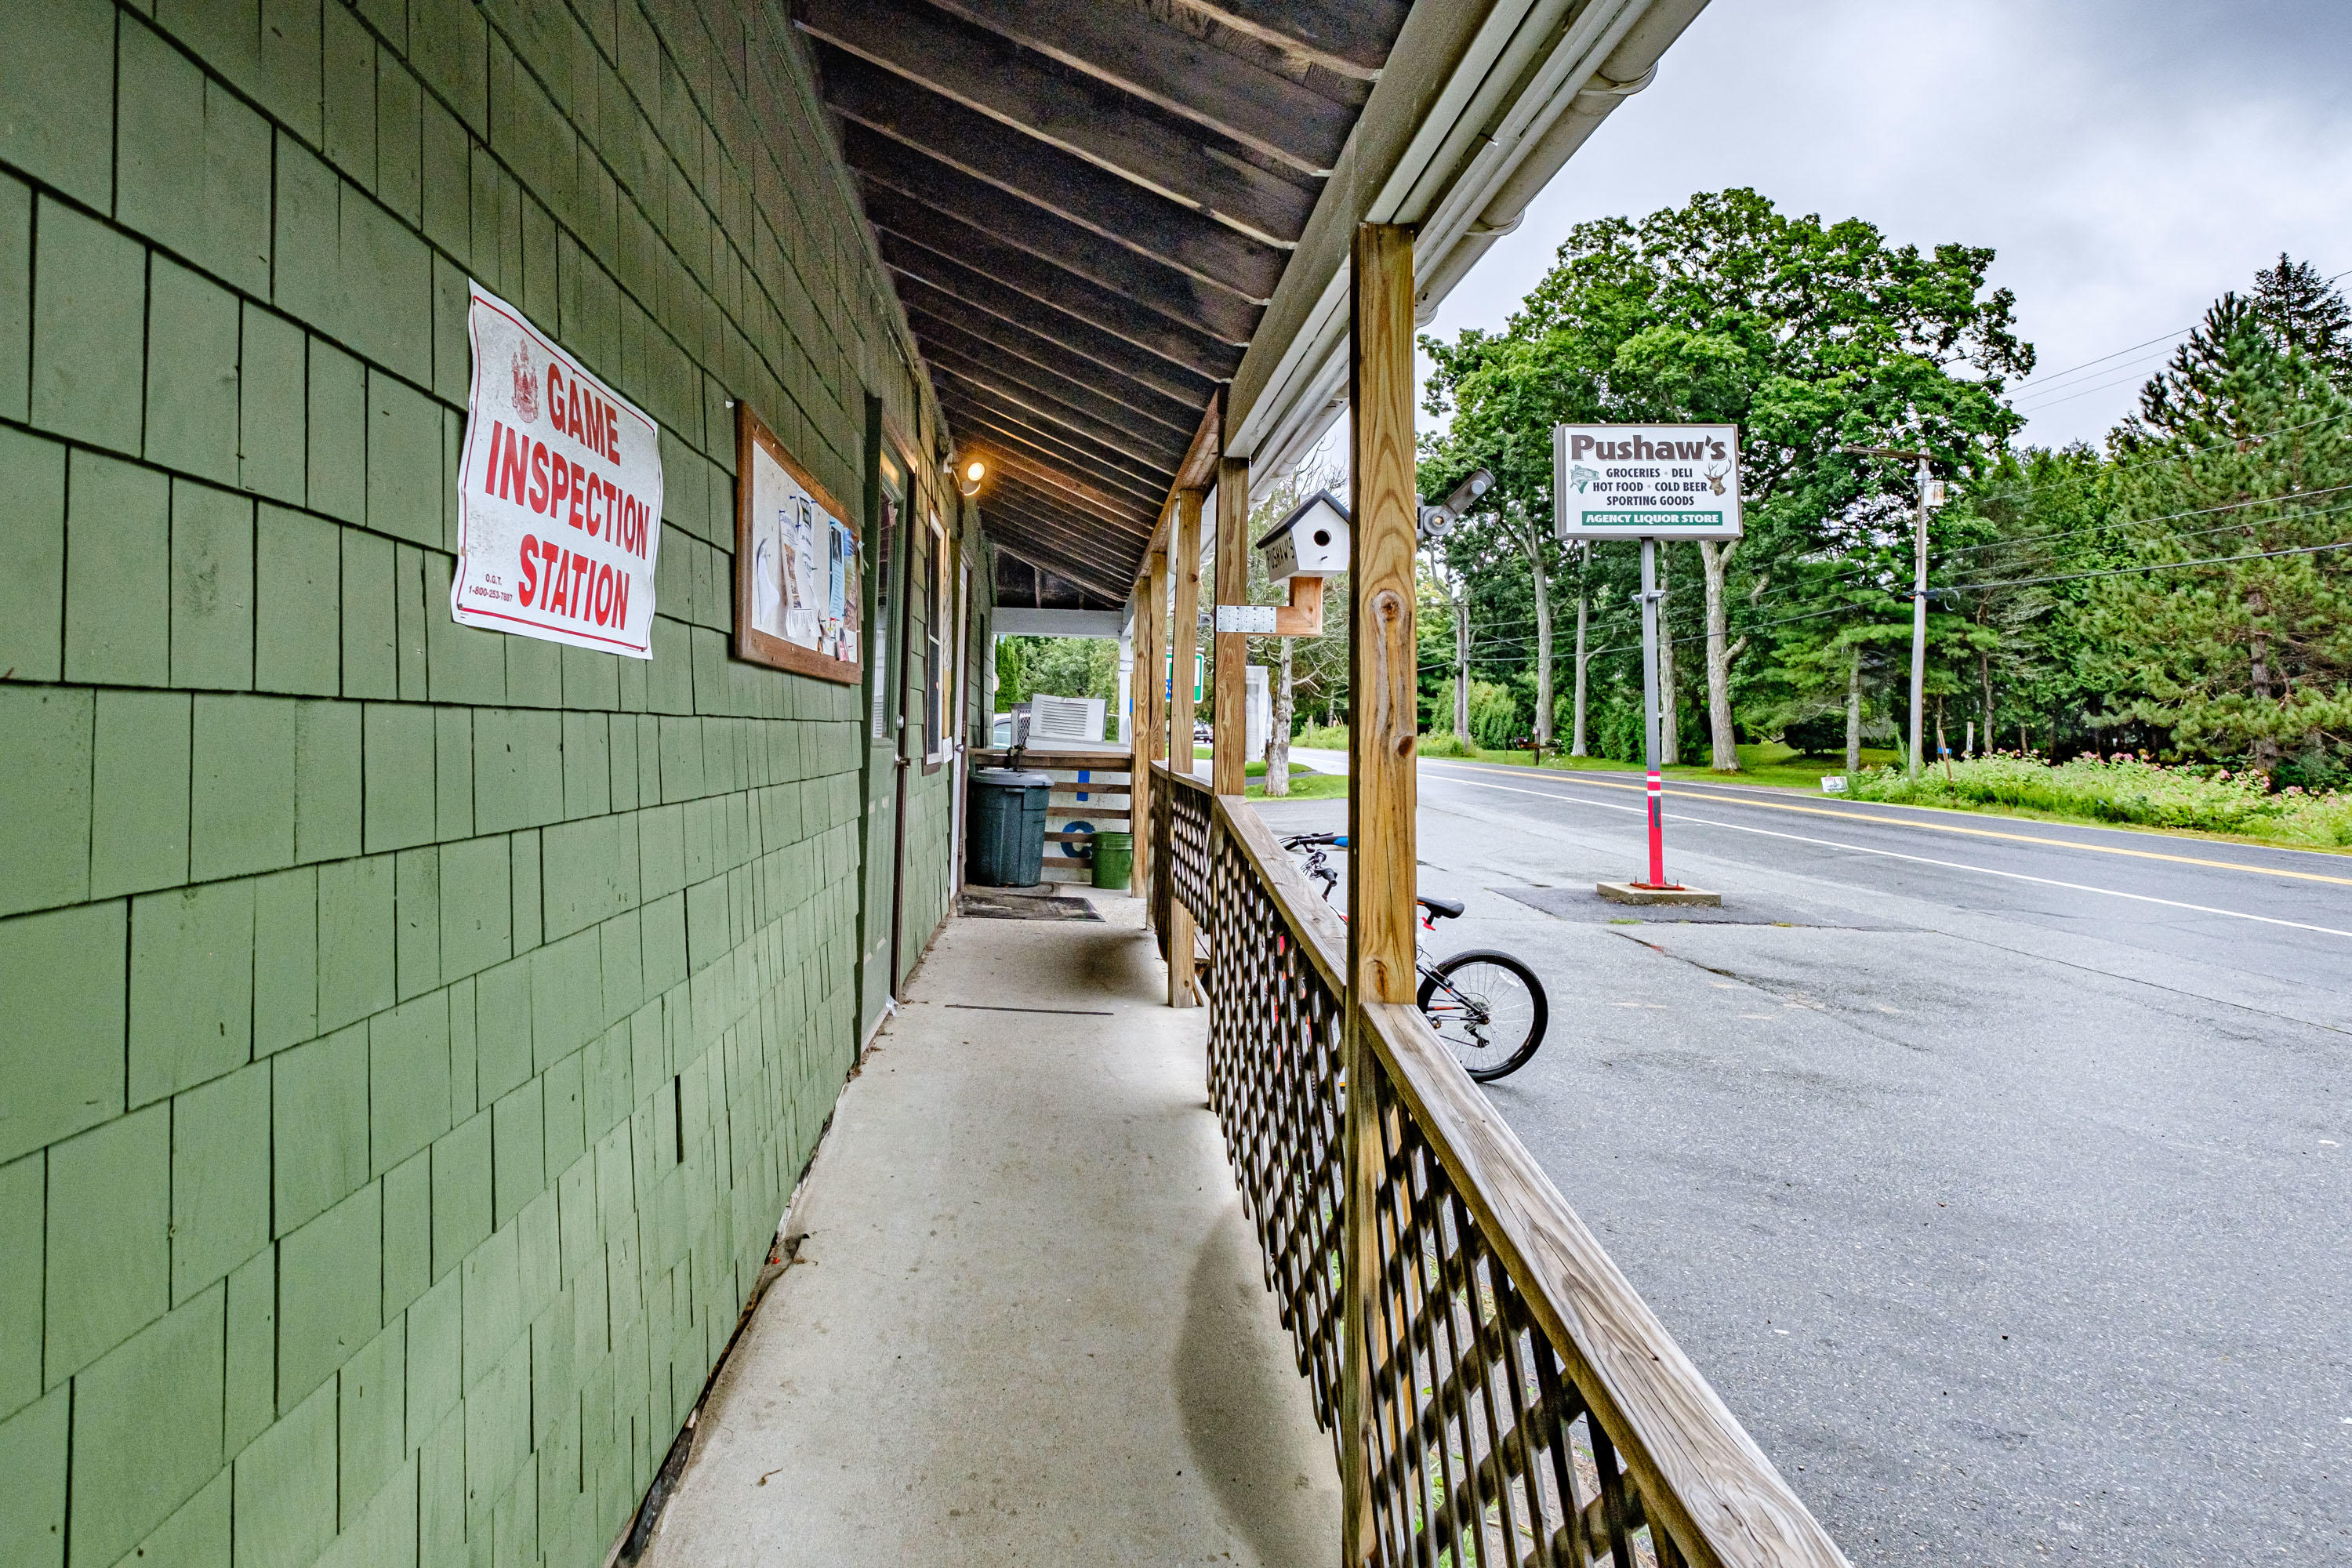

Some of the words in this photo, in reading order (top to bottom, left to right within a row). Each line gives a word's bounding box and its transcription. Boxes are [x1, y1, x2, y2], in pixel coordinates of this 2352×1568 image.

[547, 362, 620, 466] GAME
[1570, 434, 1726, 460] Pushaw's
[1606, 467, 1661, 477] GROCERIES
[1671, 467, 1693, 477] DELI
[485, 420, 651, 560] INSPECTION
[1593, 481, 1613, 492] HOT
[1616, 481, 1643, 492] FOOD
[1654, 481, 1680, 492] COLD
[1682, 481, 1708, 492] BEER
[1606, 495, 1657, 506] SPORTING
[1660, 495, 1694, 506] GOODS
[1586, 514, 1632, 523] AGENCY
[1633, 514, 1679, 524] LIQUOR
[1681, 514, 1719, 523] STORE
[485, 573, 503, 586] O.G.T.
[518, 533, 630, 630] STATION
